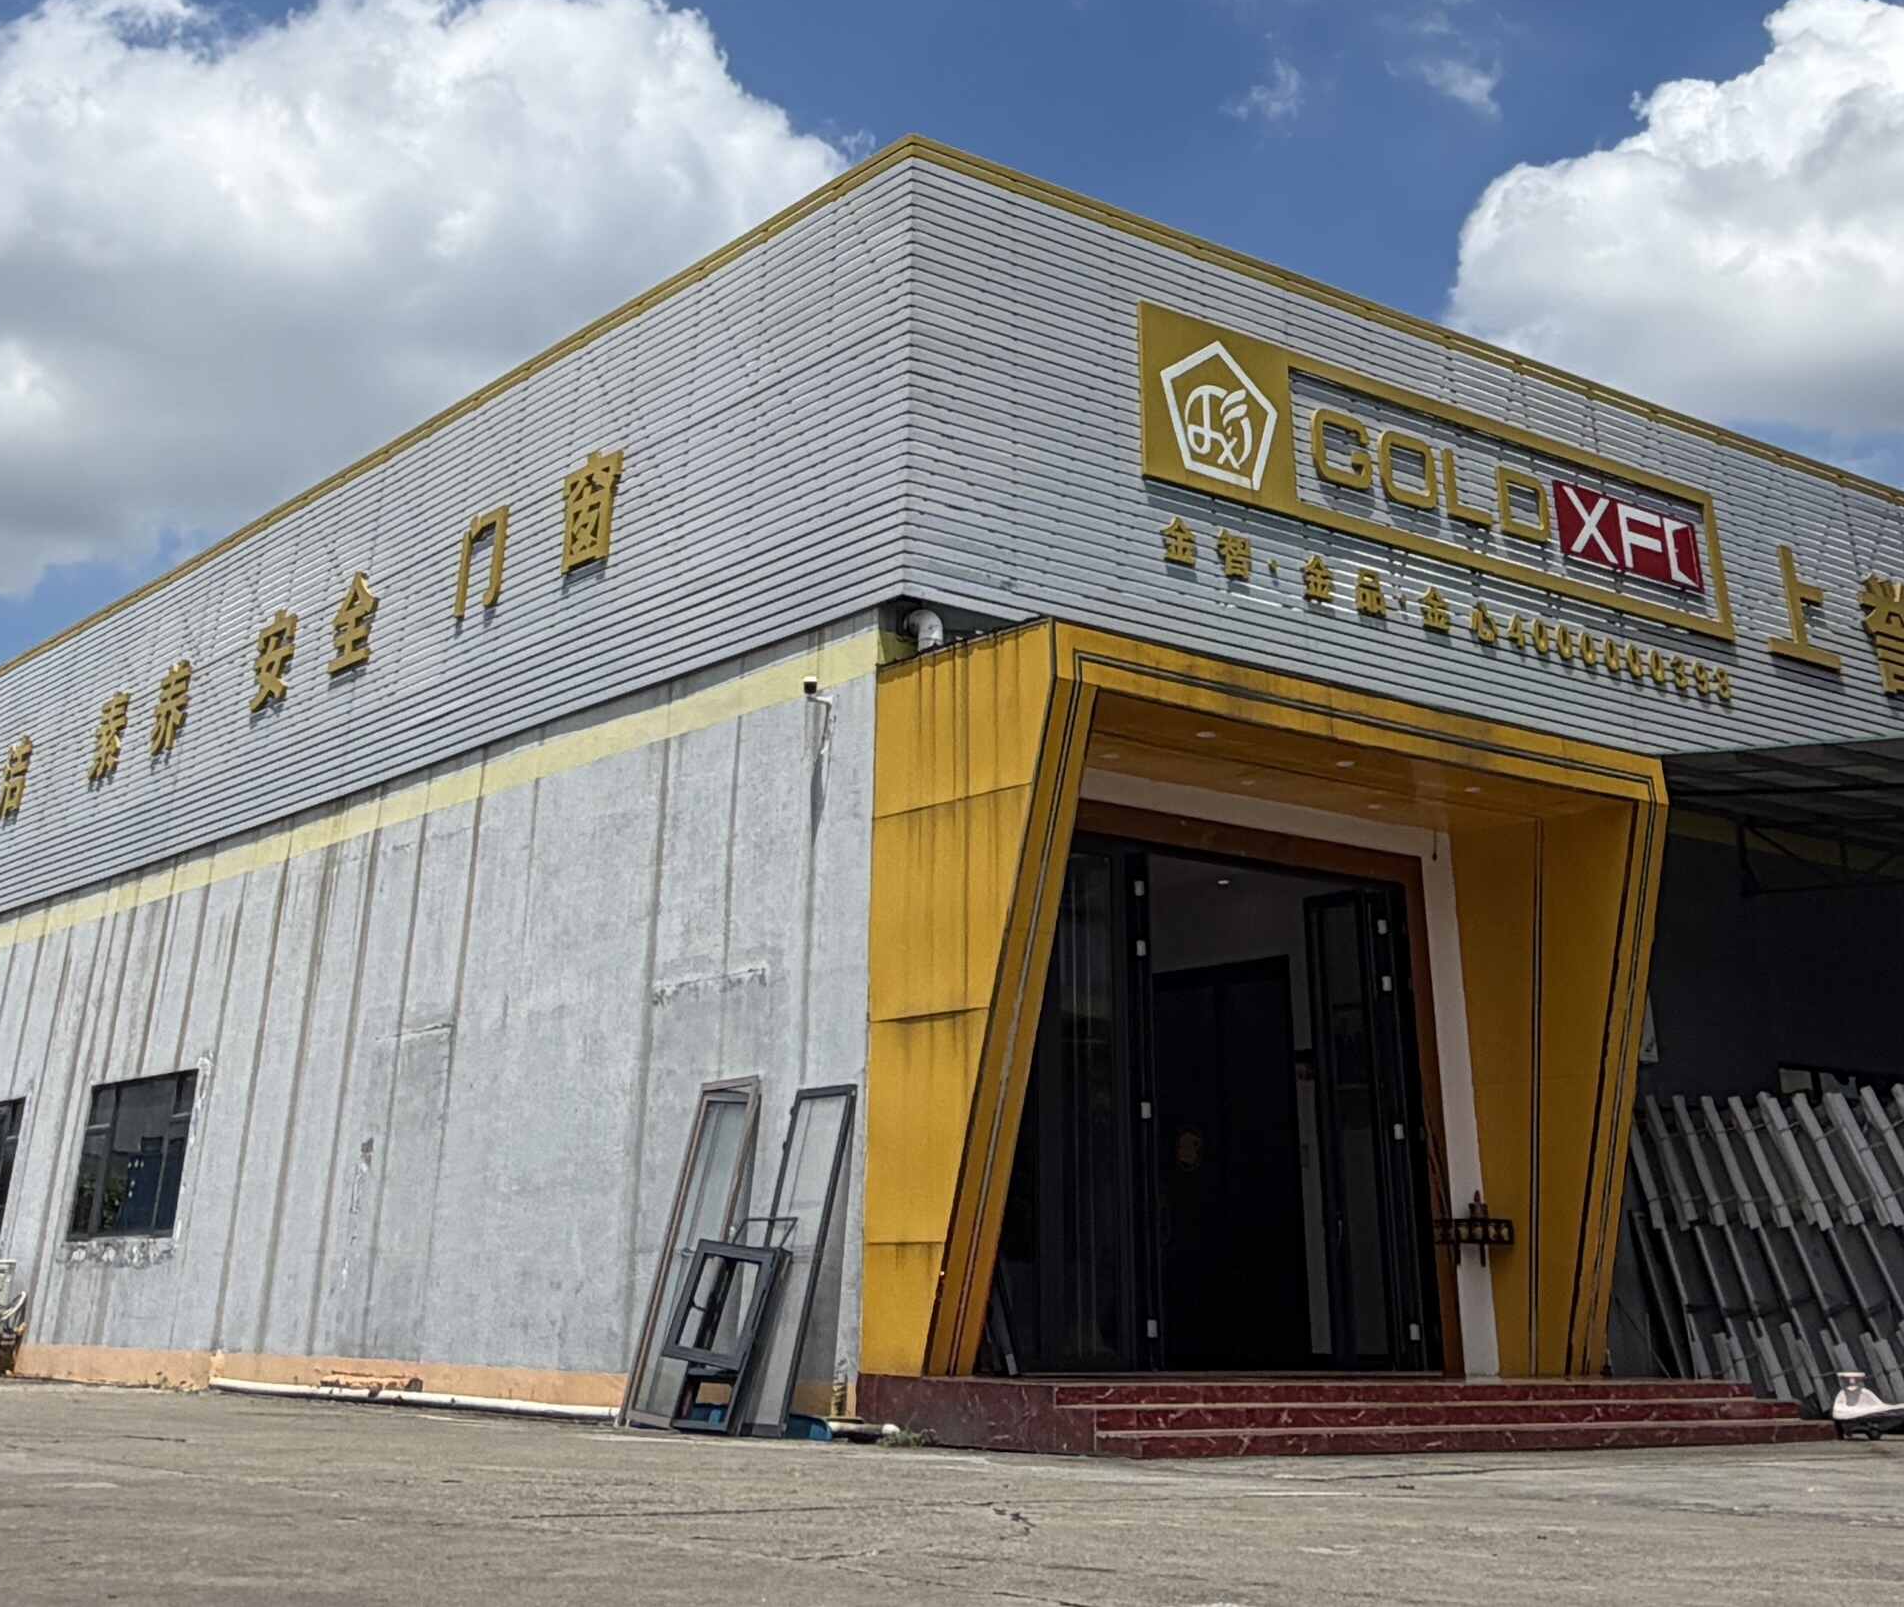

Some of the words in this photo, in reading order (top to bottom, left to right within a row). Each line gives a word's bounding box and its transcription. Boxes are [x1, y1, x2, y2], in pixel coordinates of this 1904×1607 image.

[1311, 407, 1551, 543] GOLD
[249, 570, 379, 713] 安全
[454, 449, 625, 619] 门窗
